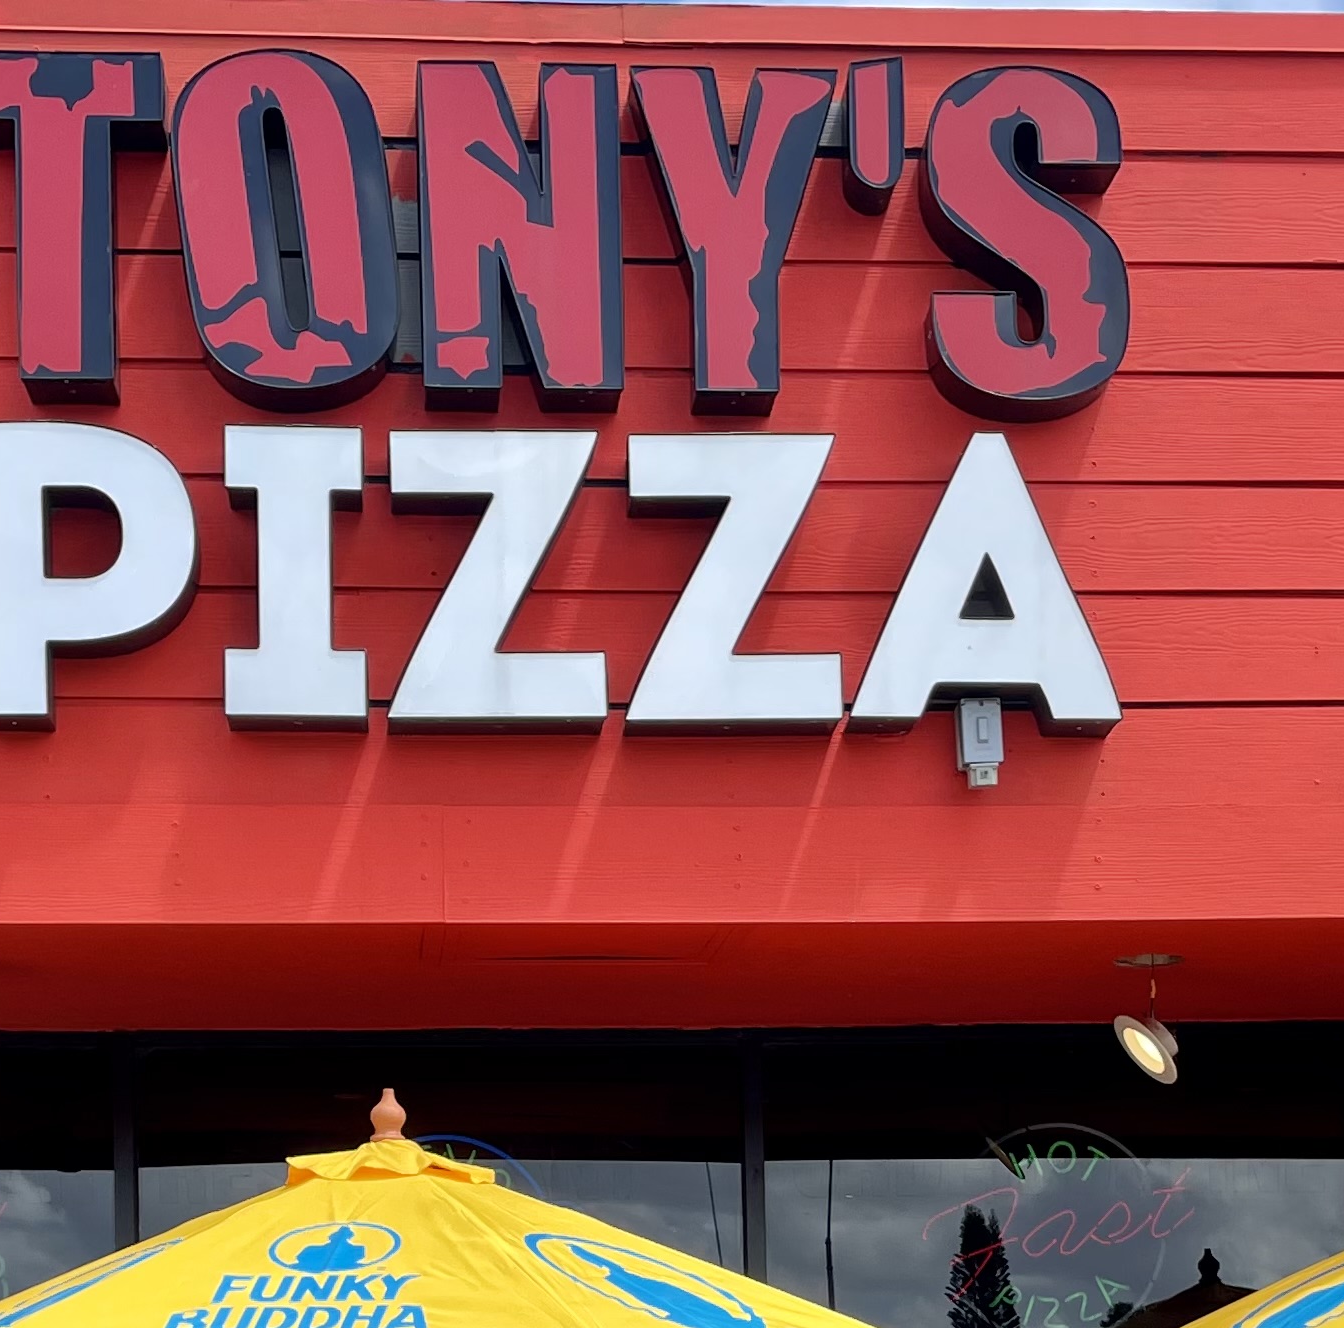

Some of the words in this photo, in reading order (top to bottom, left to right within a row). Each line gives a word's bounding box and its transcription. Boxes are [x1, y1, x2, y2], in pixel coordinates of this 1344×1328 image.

[1009, 1141, 1110, 1182] HOT
[923, 1167, 1195, 1301] Fast
[211, 1273, 422, 1304] FUNKY
